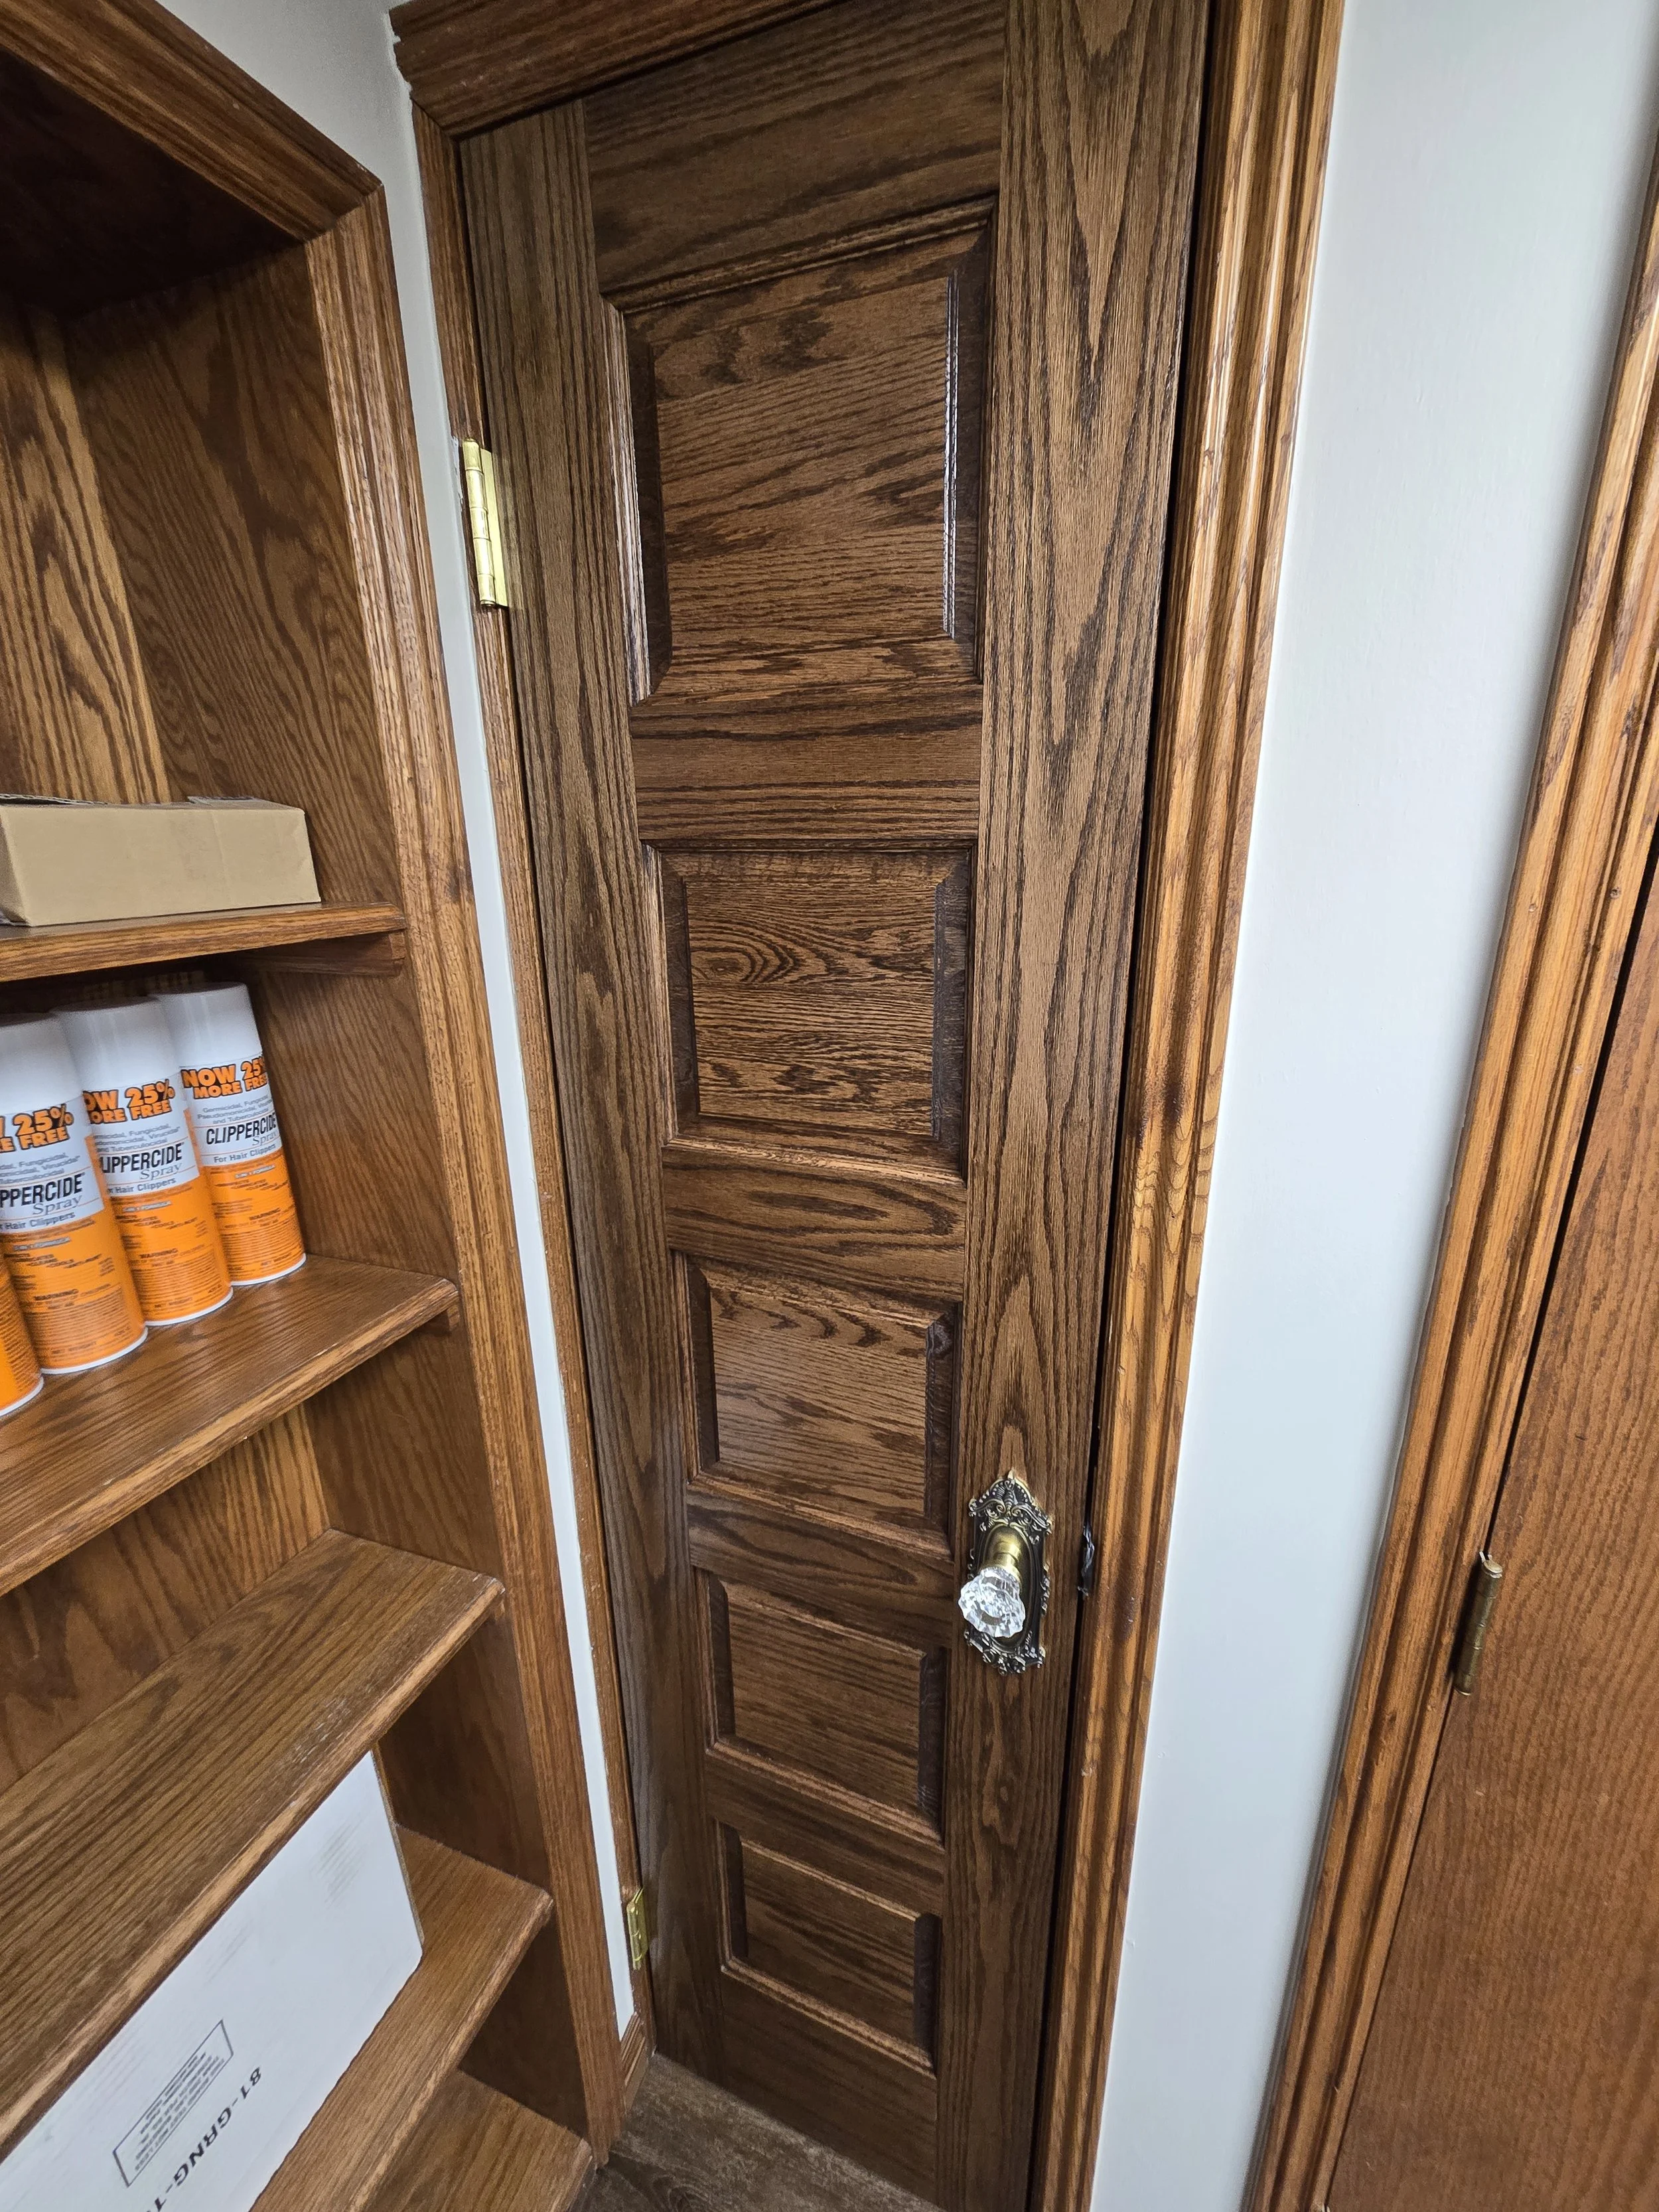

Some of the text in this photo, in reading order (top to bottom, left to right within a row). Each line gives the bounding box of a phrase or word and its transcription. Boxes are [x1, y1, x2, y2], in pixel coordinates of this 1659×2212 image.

[180, 1064, 236, 1088] NOW
[83, 1078, 176, 1111] OW 25%
[193, 1080, 243, 1100] MORE
[13, 1104, 74, 1136] 25%
[88, 1100, 173, 1124] ORE FREE
[19, 1126, 70, 1149] FREE
[206, 1112, 277, 1145] CLIPPERCIDE
[100, 1143, 182, 1173] LIPPERCIDE
[250, 1143, 276, 1156] Clippers
[140, 1162, 182, 1181] Spray
[0, 1173, 82, 1208] PPERCIDE
[137, 1177, 177, 1192] Clippers
[33, 1195, 82, 1216] Spray
[4, 1221, 26, 1230] Hair
[29, 1211, 76, 1226] Clippers
[145, 2067, 261, 2212] 81-GRNG-1
